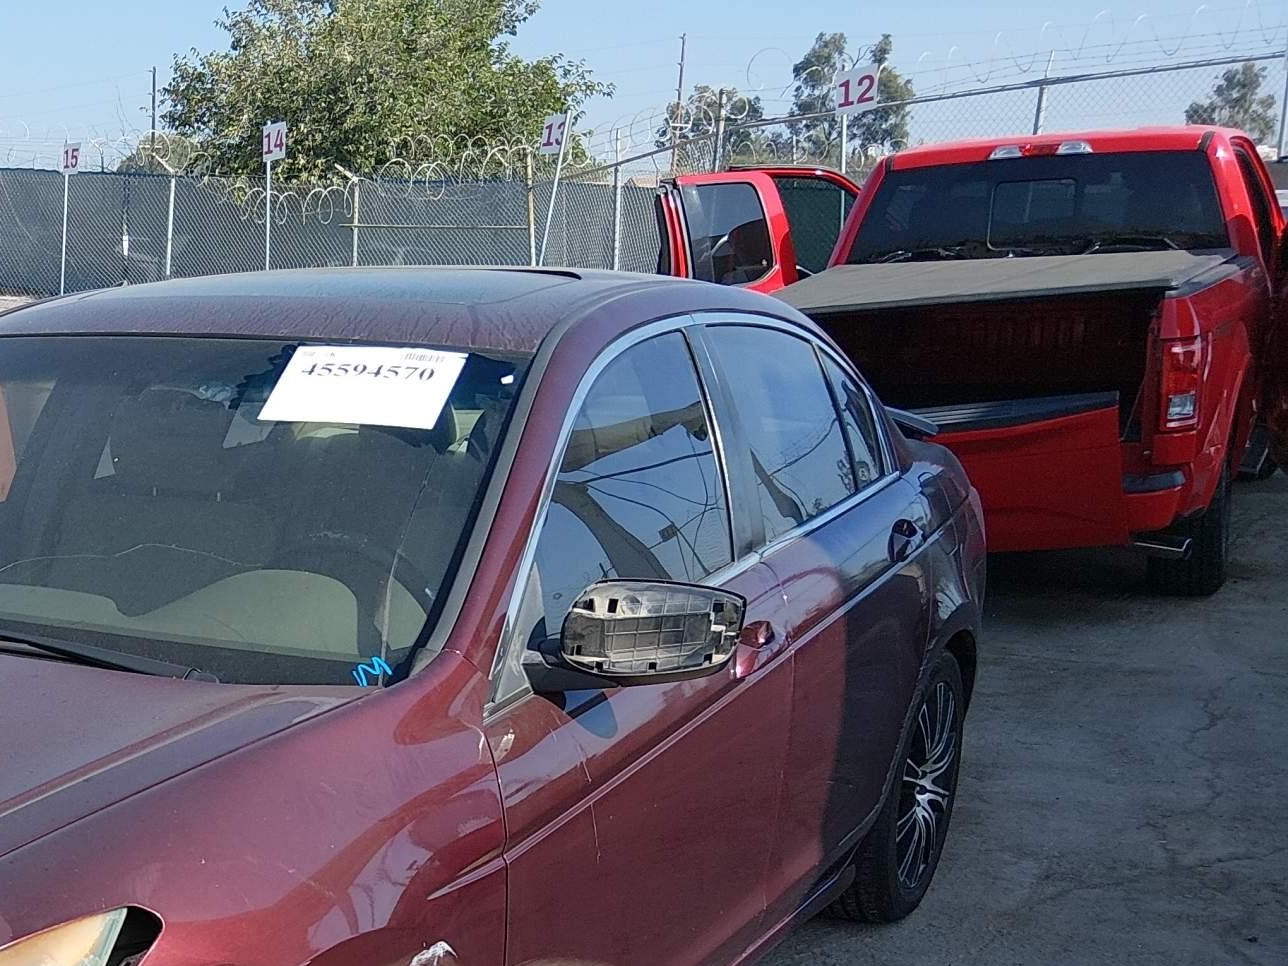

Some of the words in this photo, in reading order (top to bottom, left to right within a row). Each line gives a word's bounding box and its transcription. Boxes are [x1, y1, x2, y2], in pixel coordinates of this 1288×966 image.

[838, 74, 875, 108] 12
[264, 129, 284, 155] 14
[63, 148, 79, 169] 15
[301, 362, 435, 381] 45594570
